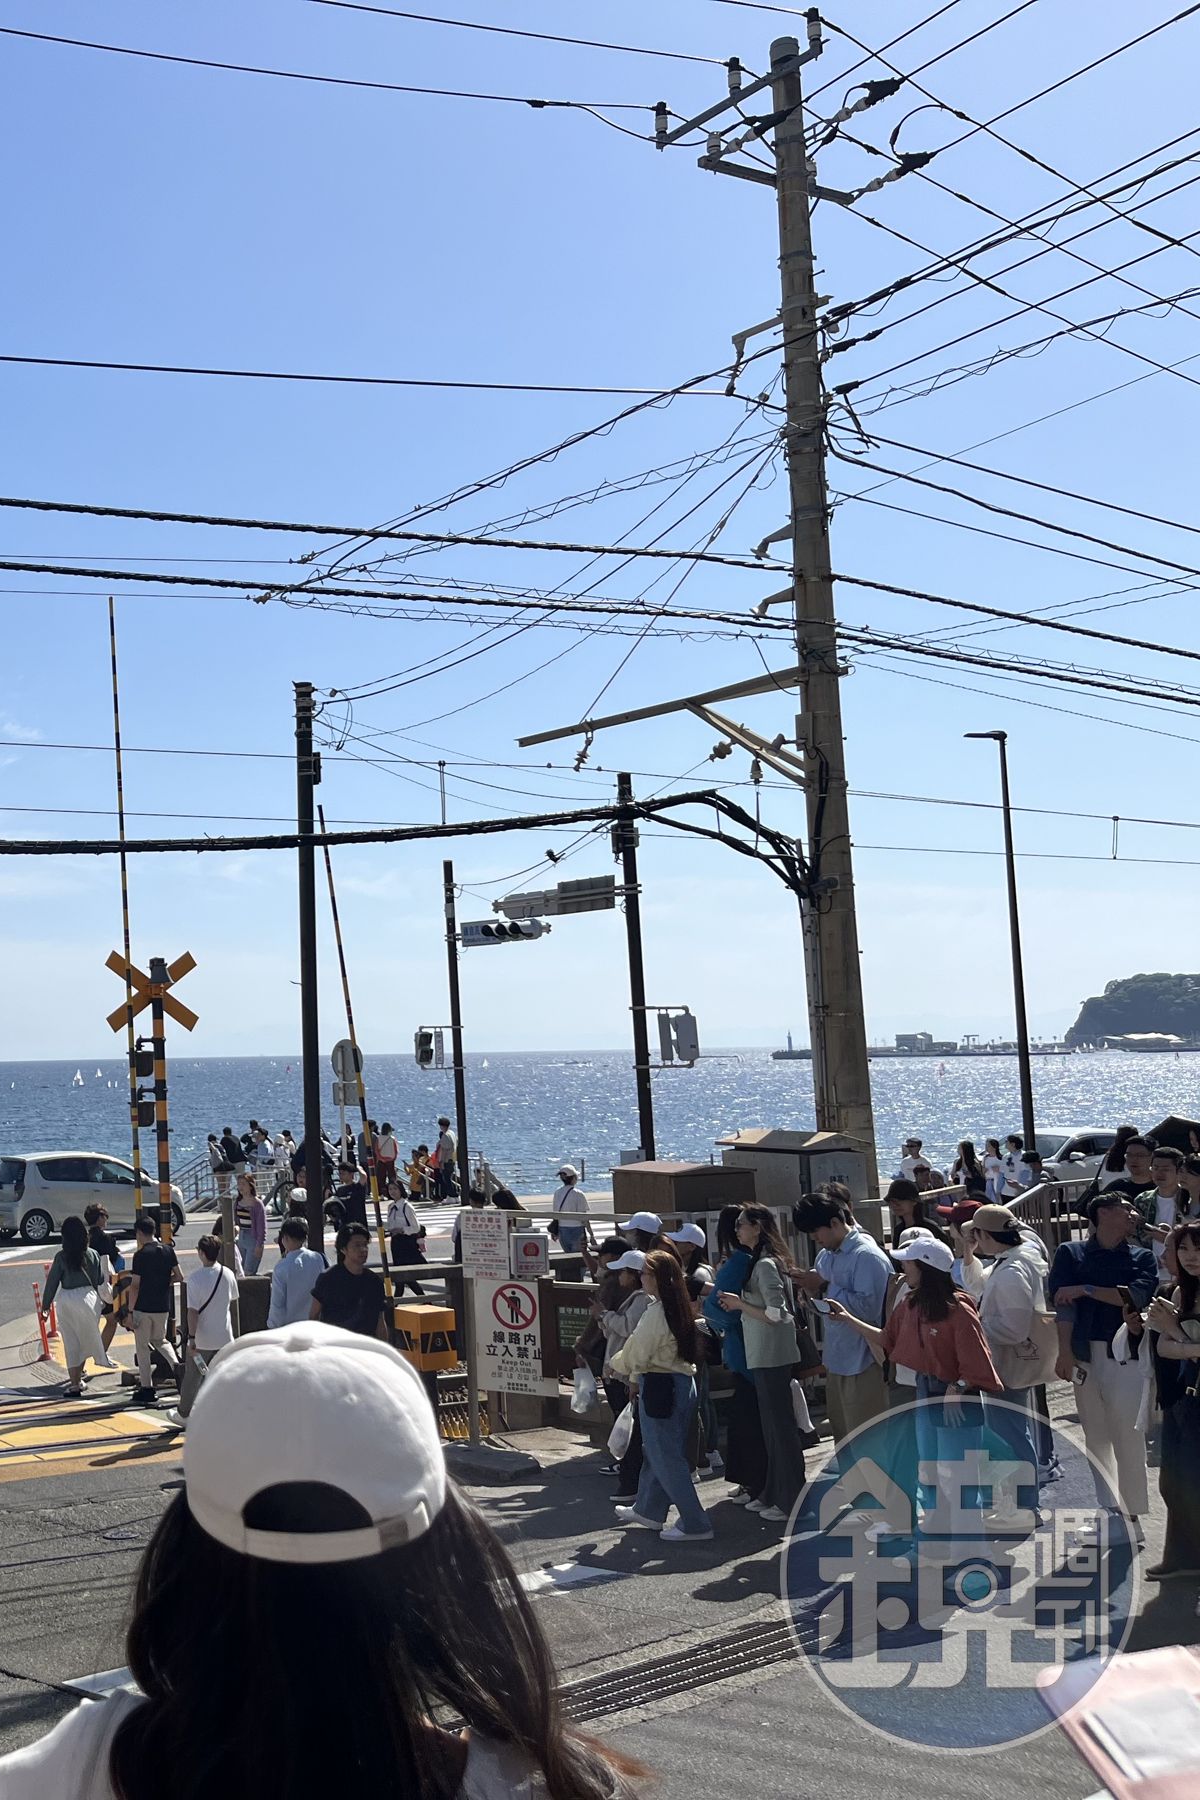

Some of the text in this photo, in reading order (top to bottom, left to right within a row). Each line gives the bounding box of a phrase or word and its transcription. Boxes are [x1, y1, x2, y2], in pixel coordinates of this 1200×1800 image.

[492, 1330, 536, 1346] 線路内
[486, 1343, 542, 1361] 立入禁止
[502, 1359, 518, 1367] Keep
